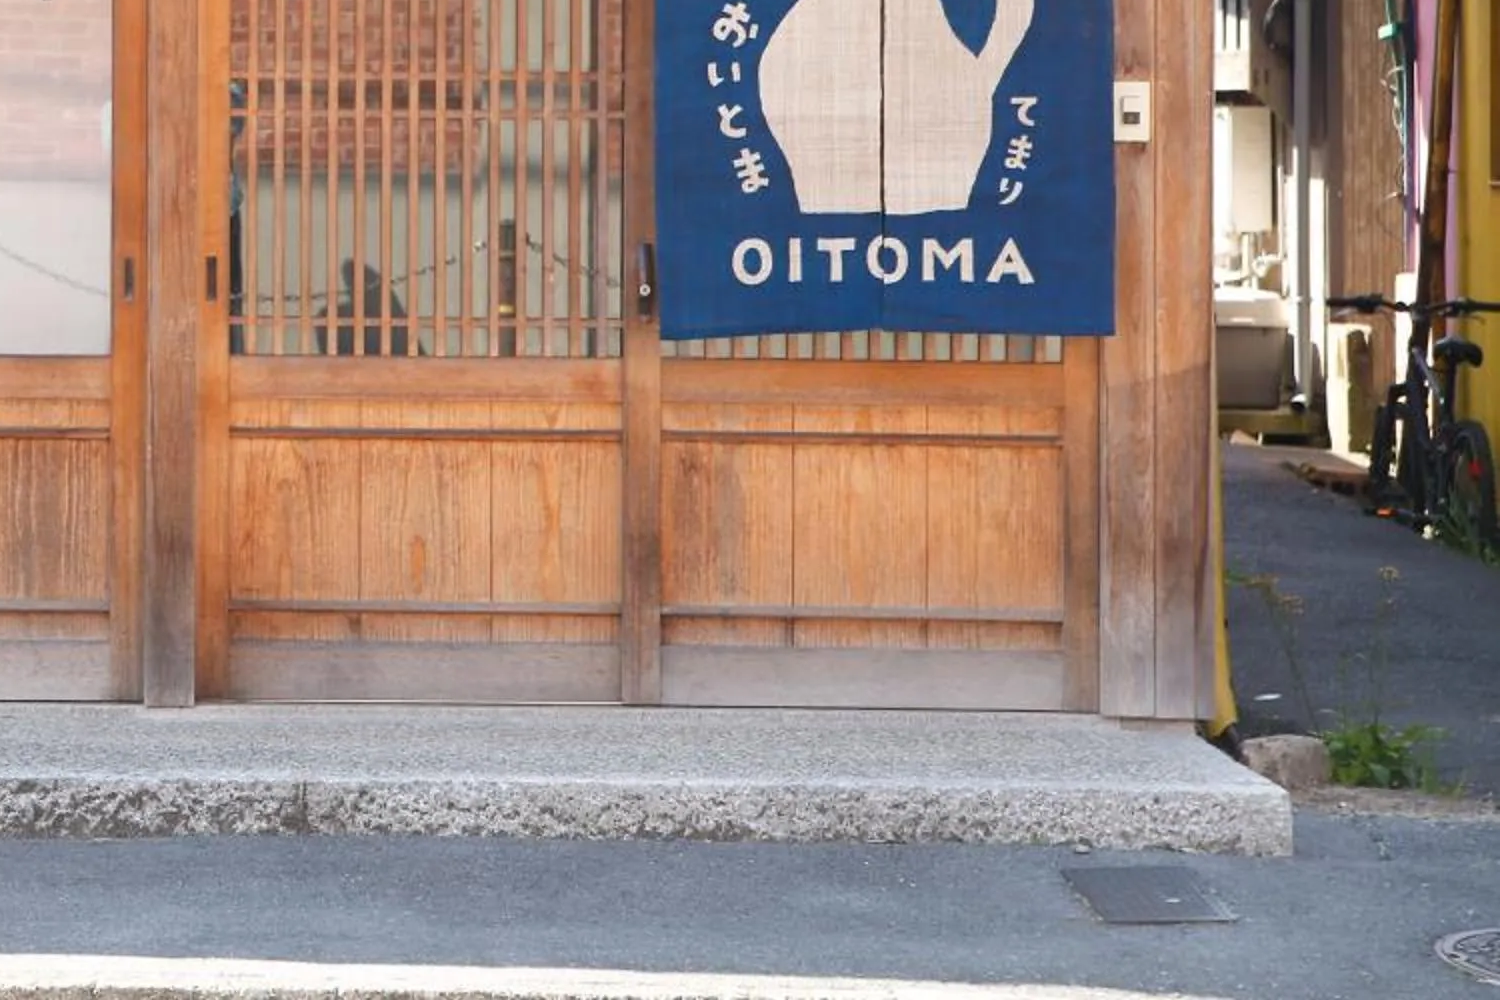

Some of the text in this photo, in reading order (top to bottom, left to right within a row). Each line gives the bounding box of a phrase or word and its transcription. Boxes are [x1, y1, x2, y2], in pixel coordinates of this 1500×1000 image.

[707, 2, 769, 194] おいとま
[999, 96, 1039, 205] てまり
[731, 236, 1036, 286] OITOMA
